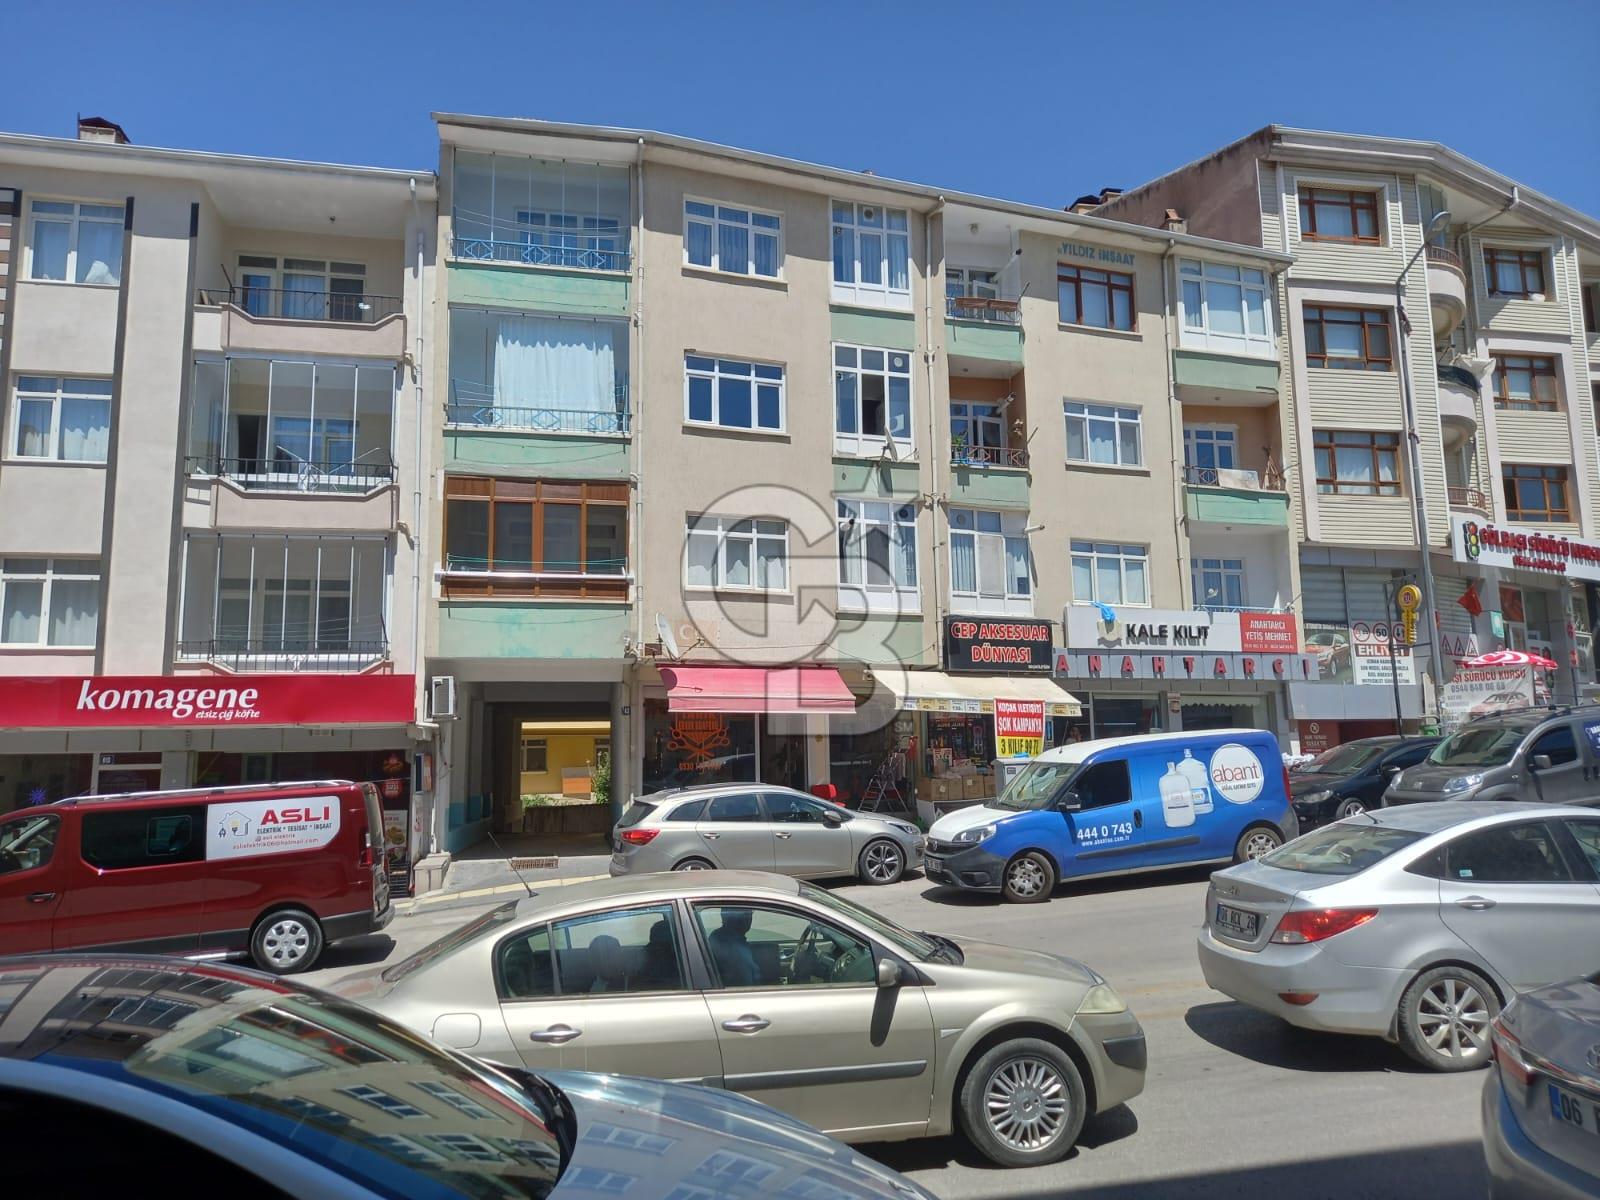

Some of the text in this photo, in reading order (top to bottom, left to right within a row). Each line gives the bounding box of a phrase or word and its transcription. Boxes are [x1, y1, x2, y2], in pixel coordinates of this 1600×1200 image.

[1062, 242, 1095, 259] YILDIZ
[951, 622, 1049, 641] CEP AKSESUAR
[1126, 623, 1169, 639] KALE
[1264, 632, 1292, 642] MEHMET
[1375, 628, 1388, 638] 50
[971, 643, 1032, 664] DÜNYASI
[1055, 654, 1311, 675] ANAHTARCI
[77, 680, 257, 718] komagene
[196, 710, 217, 718] etsiz
[234, 709, 260, 718] köfte
[998, 717, 1041, 736] ŞOK KAMPANYA
[1000, 739, 1006, 754] 3
[1212, 763, 1259, 783] abant
[260, 806, 330, 825] ASLI
[1077, 822, 1133, 840] 444 0 743
[1561, 1093, 1583, 1126] 06
